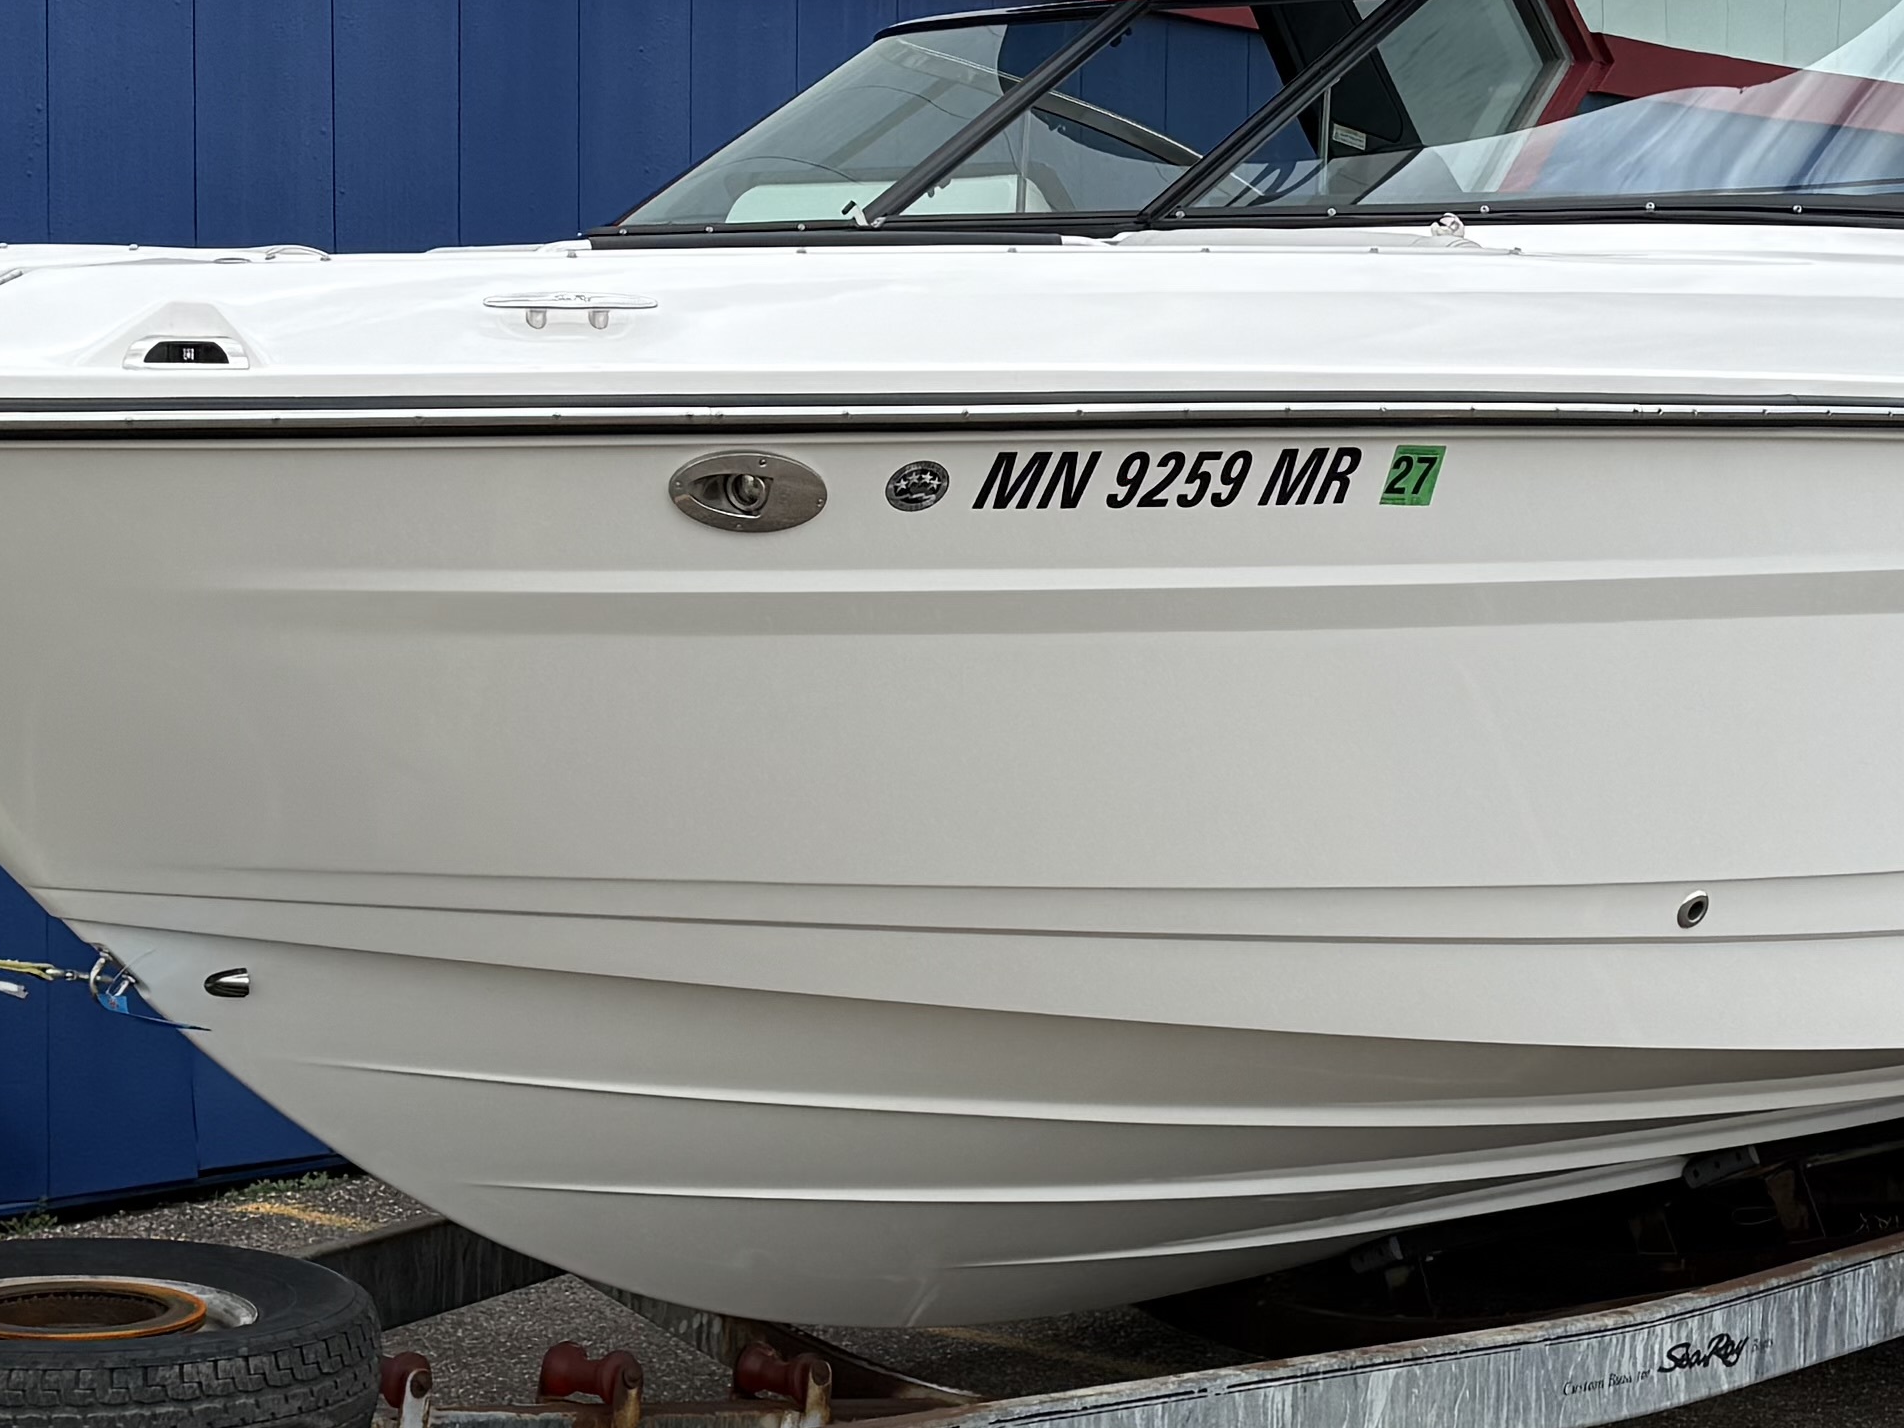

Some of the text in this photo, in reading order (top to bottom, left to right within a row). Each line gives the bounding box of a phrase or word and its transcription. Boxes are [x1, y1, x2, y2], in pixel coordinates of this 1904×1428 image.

[972, 447, 1363, 510] MN 9259 MR
[1383, 455, 1438, 495] 27
